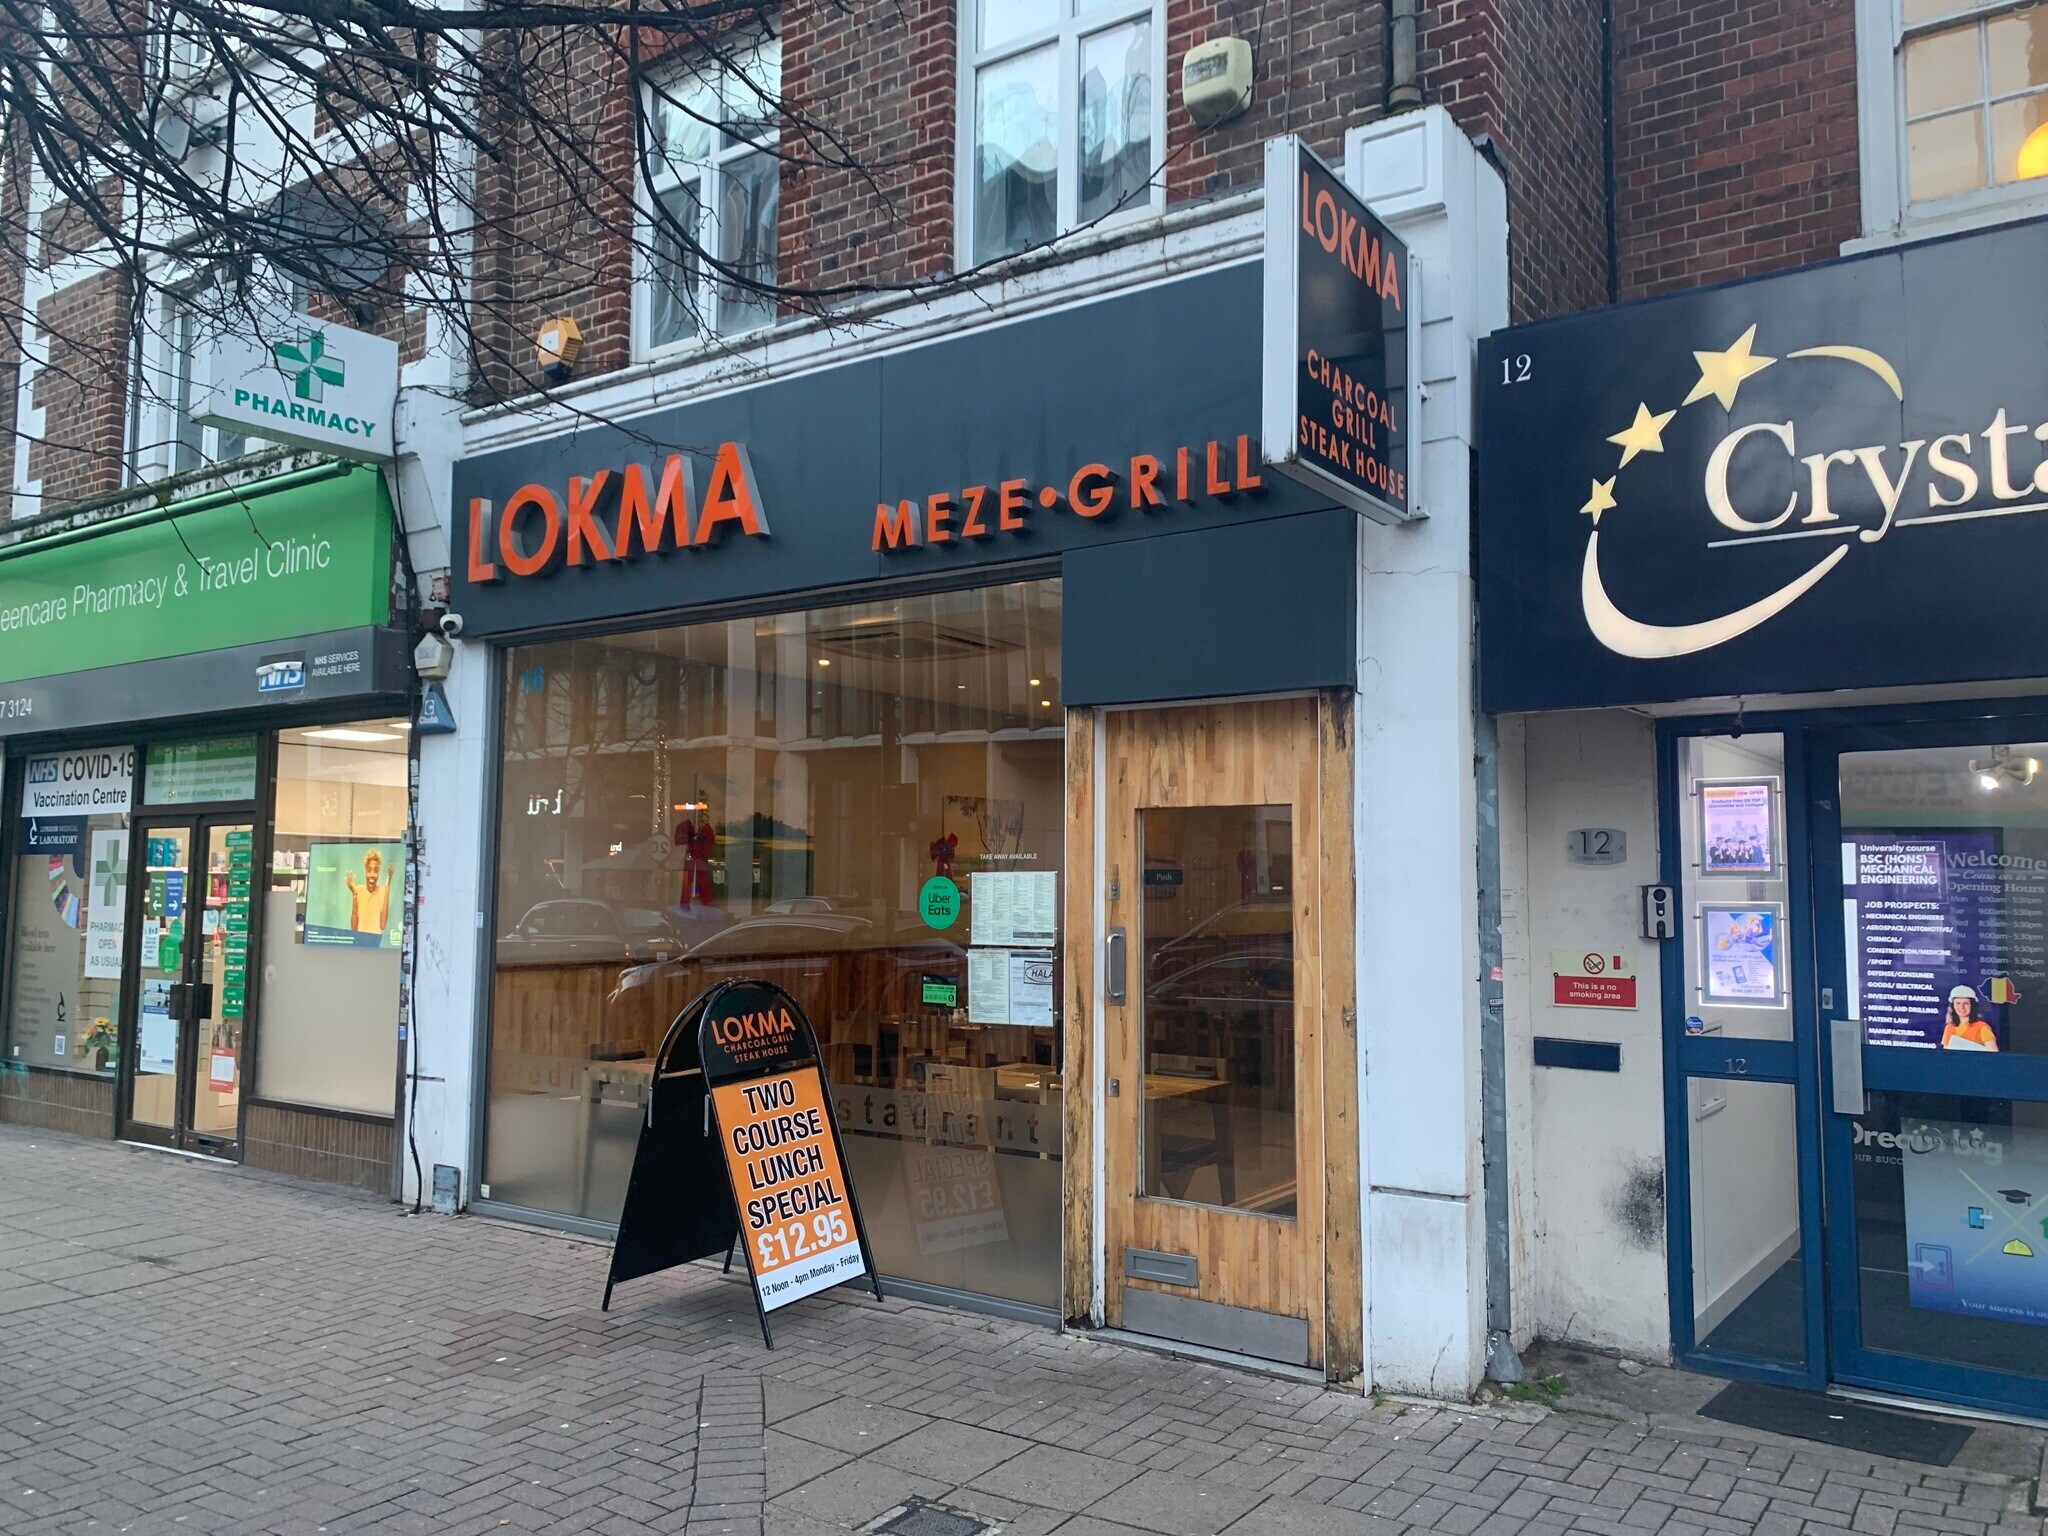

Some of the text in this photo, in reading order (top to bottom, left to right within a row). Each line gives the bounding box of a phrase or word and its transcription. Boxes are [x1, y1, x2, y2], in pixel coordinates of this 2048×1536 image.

[1303, 170, 1401, 312] LOKMA
[1501, 354, 1532, 385] 12
[1307, 348, 1397, 432] CHARCOAL
[235, 388, 376, 437] PHARMACY
[1332, 400, 1376, 450] GRILL
[1301, 414, 1404, 500] STEAK HOUSE
[1705, 408, 2048, 542] Cryst
[468, 441, 770, 584] LOKMA
[73, 575, 168, 617] Pharmacy
[174, 563, 189, 597] &
[196, 547, 259, 592] Travel
[266, 533, 331, 578] Clinic
[314, 651, 359, 665] NHS SERVICES
[311, 662, 361, 677] AVAILABLE HERE
[521, 666, 545, 693] 16
[8, 698, 33, 718] 3124
[420, 716, 438, 724] Chubb
[30, 760, 58, 782] NHS
[63, 752, 134, 781] COVID-19
[34, 788, 127, 808] Vaccination Centre
[39, 835, 78, 844] LABORATORY
[1580, 831, 1610, 854] 12
[1860, 844, 1905, 853] University
[1860, 854, 1927, 866] BSC (HONS)
[1947, 850, 2047, 872] Welcome
[1156, 872, 1172, 881] Push
[1860, 865, 1936, 874] MECHANICAL
[1963, 869, 1996, 880] Come
[1861, 875, 1938, 885] ENGINEERING
[1947, 881, 2045, 893] Opening Hours
[928, 892, 951, 904] Uber
[1865, 901, 1940, 910] JOB PROSPECTS:
[928, 904, 951, 916] Eats
[98, 939, 117, 950] OPEN
[1866, 947, 1951, 956] CONSTRUCTION/MEDICINE
[90, 955, 100, 966] AS
[1867, 970, 1935, 979] DEFENSE/CONSUMER
[1591, 982, 1598, 990] is
[1867, 981, 1934, 990] GOODS/ ELECTRICAL
[1569, 991, 1602, 1000] smoking
[1867, 993, 1908, 1001] INVESTMENT
[1908, 1006, 1939, 1014] DRILLING
[711, 1008, 796, 1045] LOKMA
[1869, 1028, 1925, 1037] MANUFACTURING
[724, 1033, 794, 1053] CHARCOAL GRILL
[1893, 1040, 1937, 1049] ENGINEERING
[734, 1045, 788, 1064] STEAK HOUSE
[1725, 1058, 1747, 1074] 12
[742, 1079, 796, 1116] TWO
[732, 1109, 823, 1155] COURSE
[747, 1145, 824, 1191] LUNCH
[747, 1178, 843, 1229] SPECIAL
[758, 1209, 848, 1268] £12.95
[762, 1253, 859, 1297] 12 Noon 4pm Monday Friday
[1988, 1304, 2024, 1315] success
